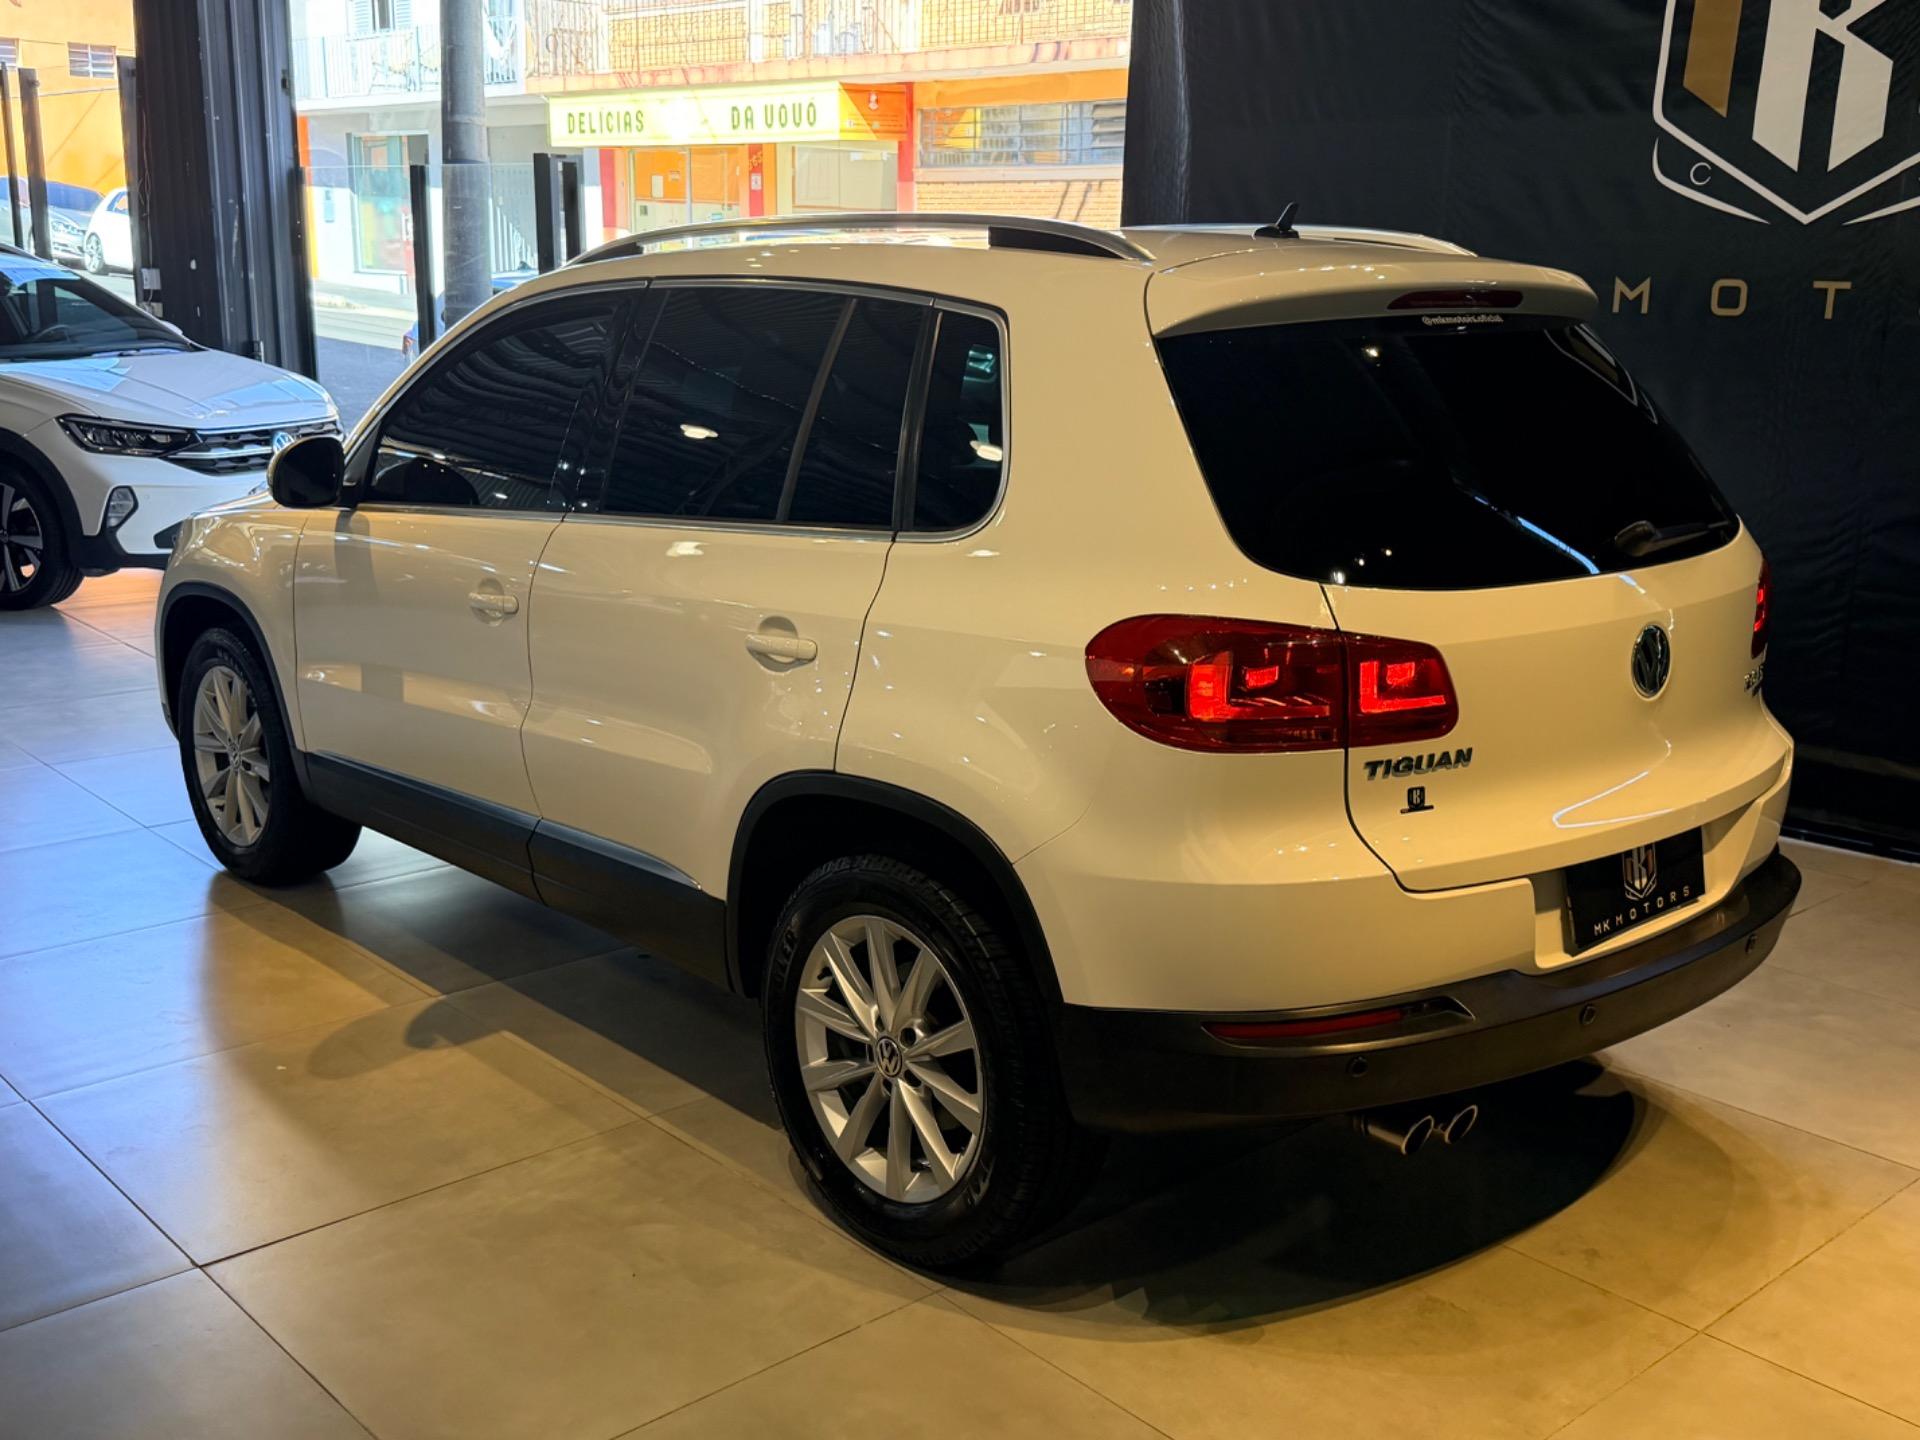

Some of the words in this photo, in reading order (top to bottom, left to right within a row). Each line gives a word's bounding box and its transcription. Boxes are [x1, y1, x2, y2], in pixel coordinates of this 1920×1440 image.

[731, 105, 754, 131] DA
[1363, 747, 1473, 781] TIGUAN
[1615, 884, 1691, 926] MOTORS
